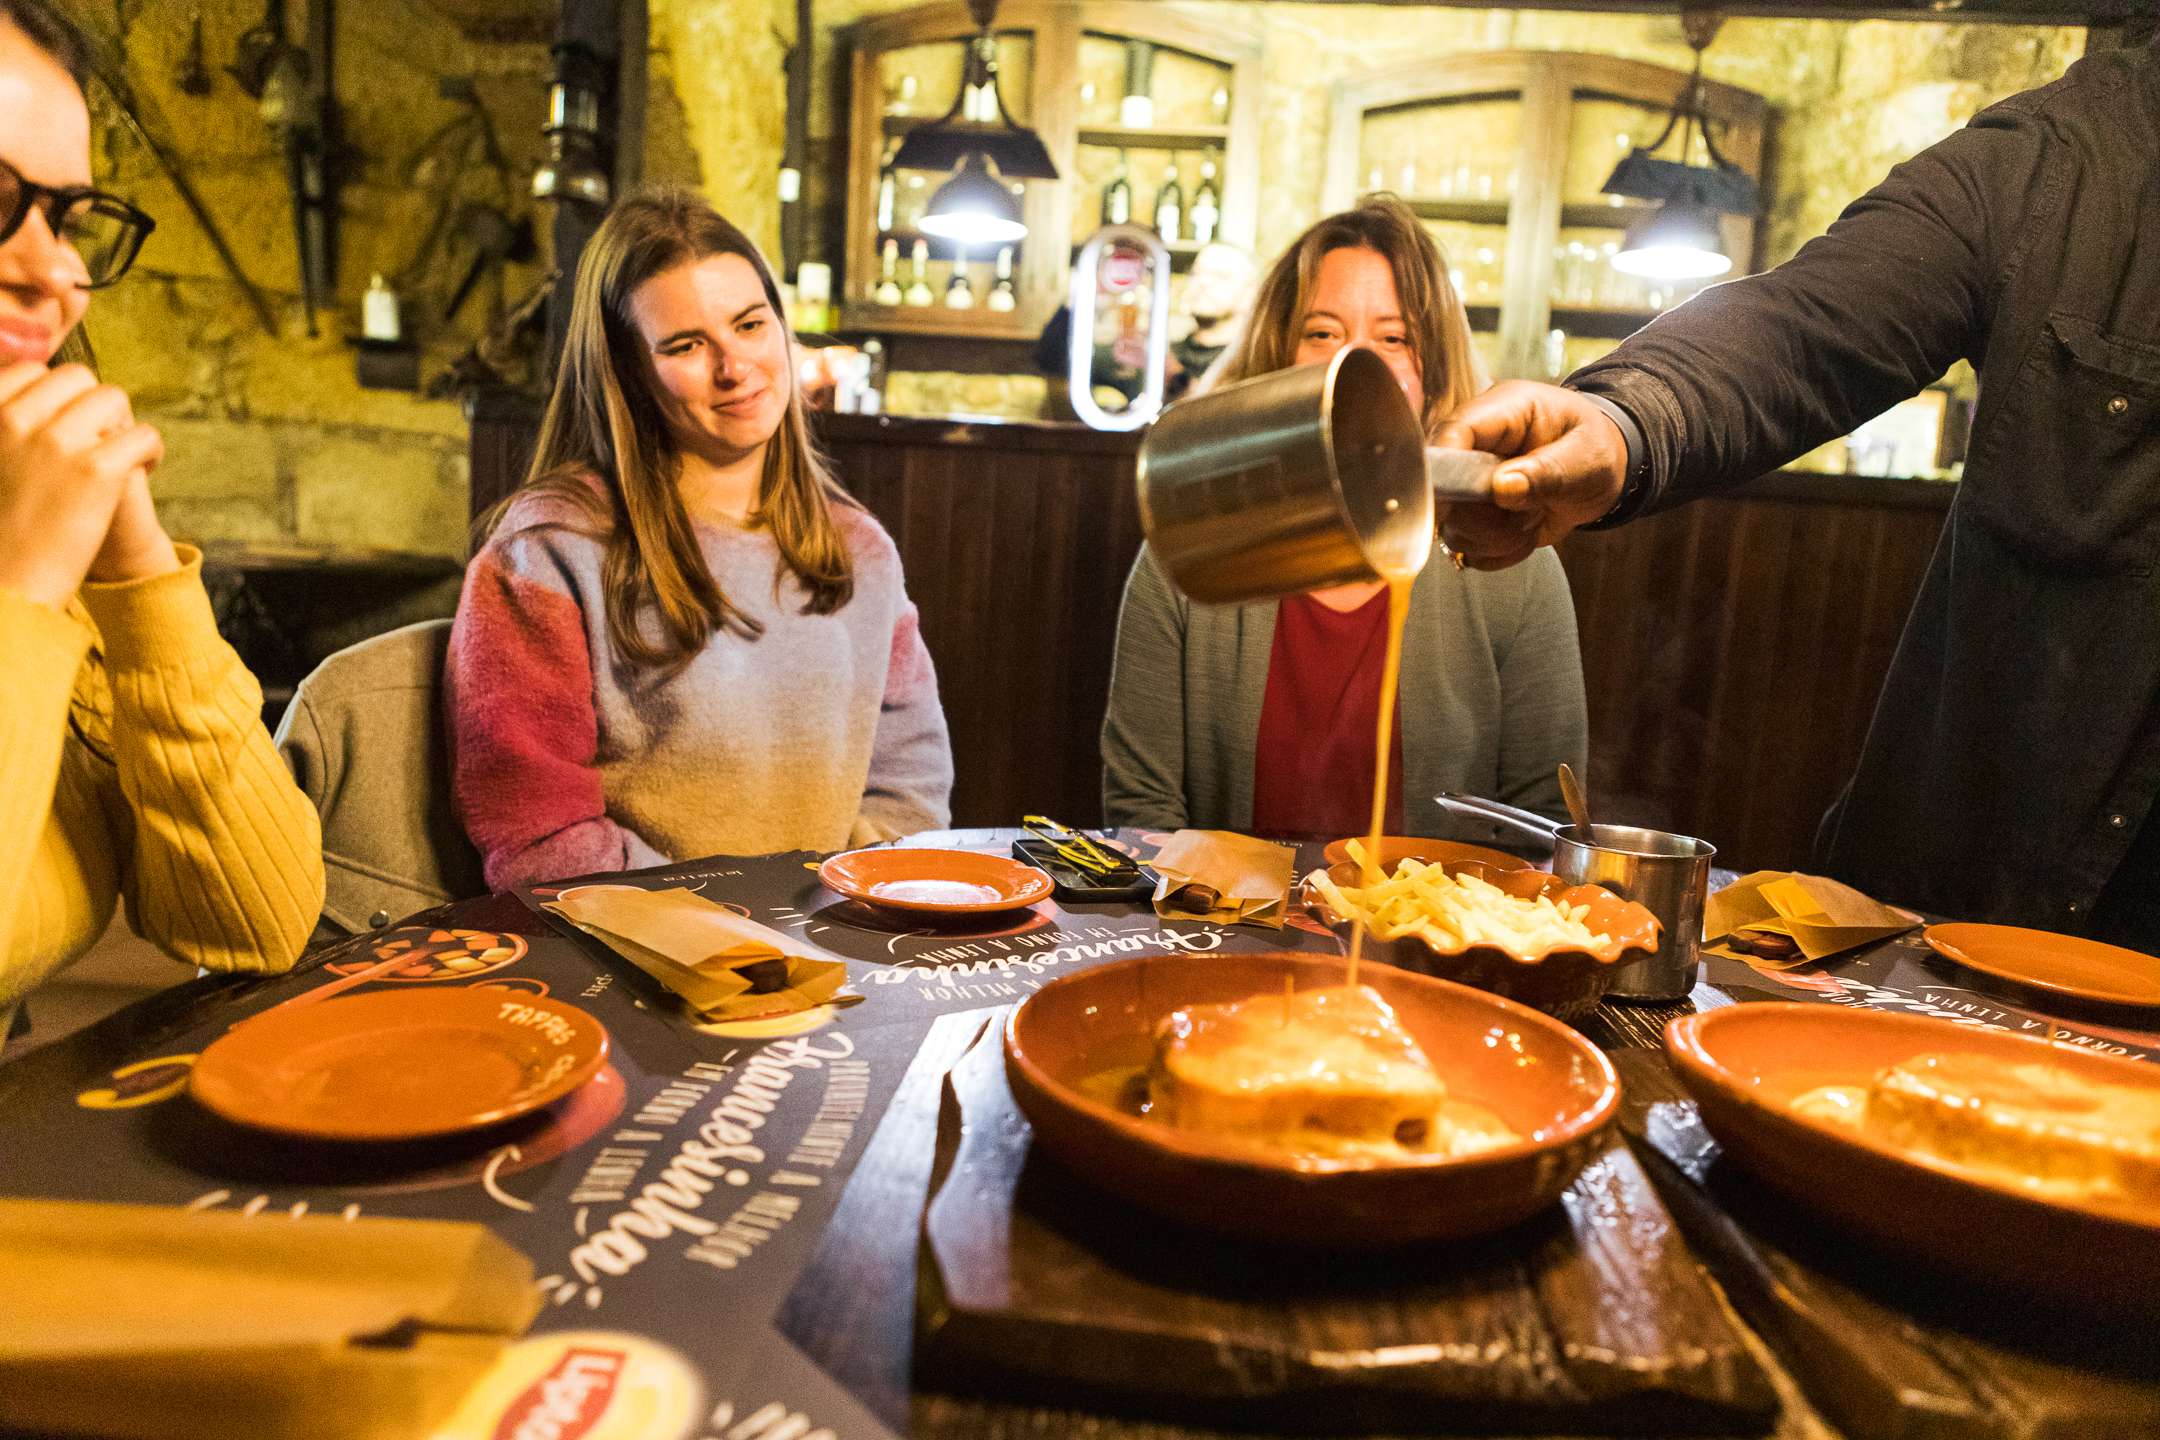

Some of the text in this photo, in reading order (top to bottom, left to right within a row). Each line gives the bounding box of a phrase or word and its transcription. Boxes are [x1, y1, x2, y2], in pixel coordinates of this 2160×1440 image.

[859, 927, 1223, 987] Francesinha
[914, 926, 1118, 964] EM FORNO A LENHA
[918, 982, 1018, 1001] MELHOR
[1924, 992, 2008, 1021] LENHA
[2021, 1018, 2043, 1030] A
[569, 1031, 855, 1284] Francesinha
